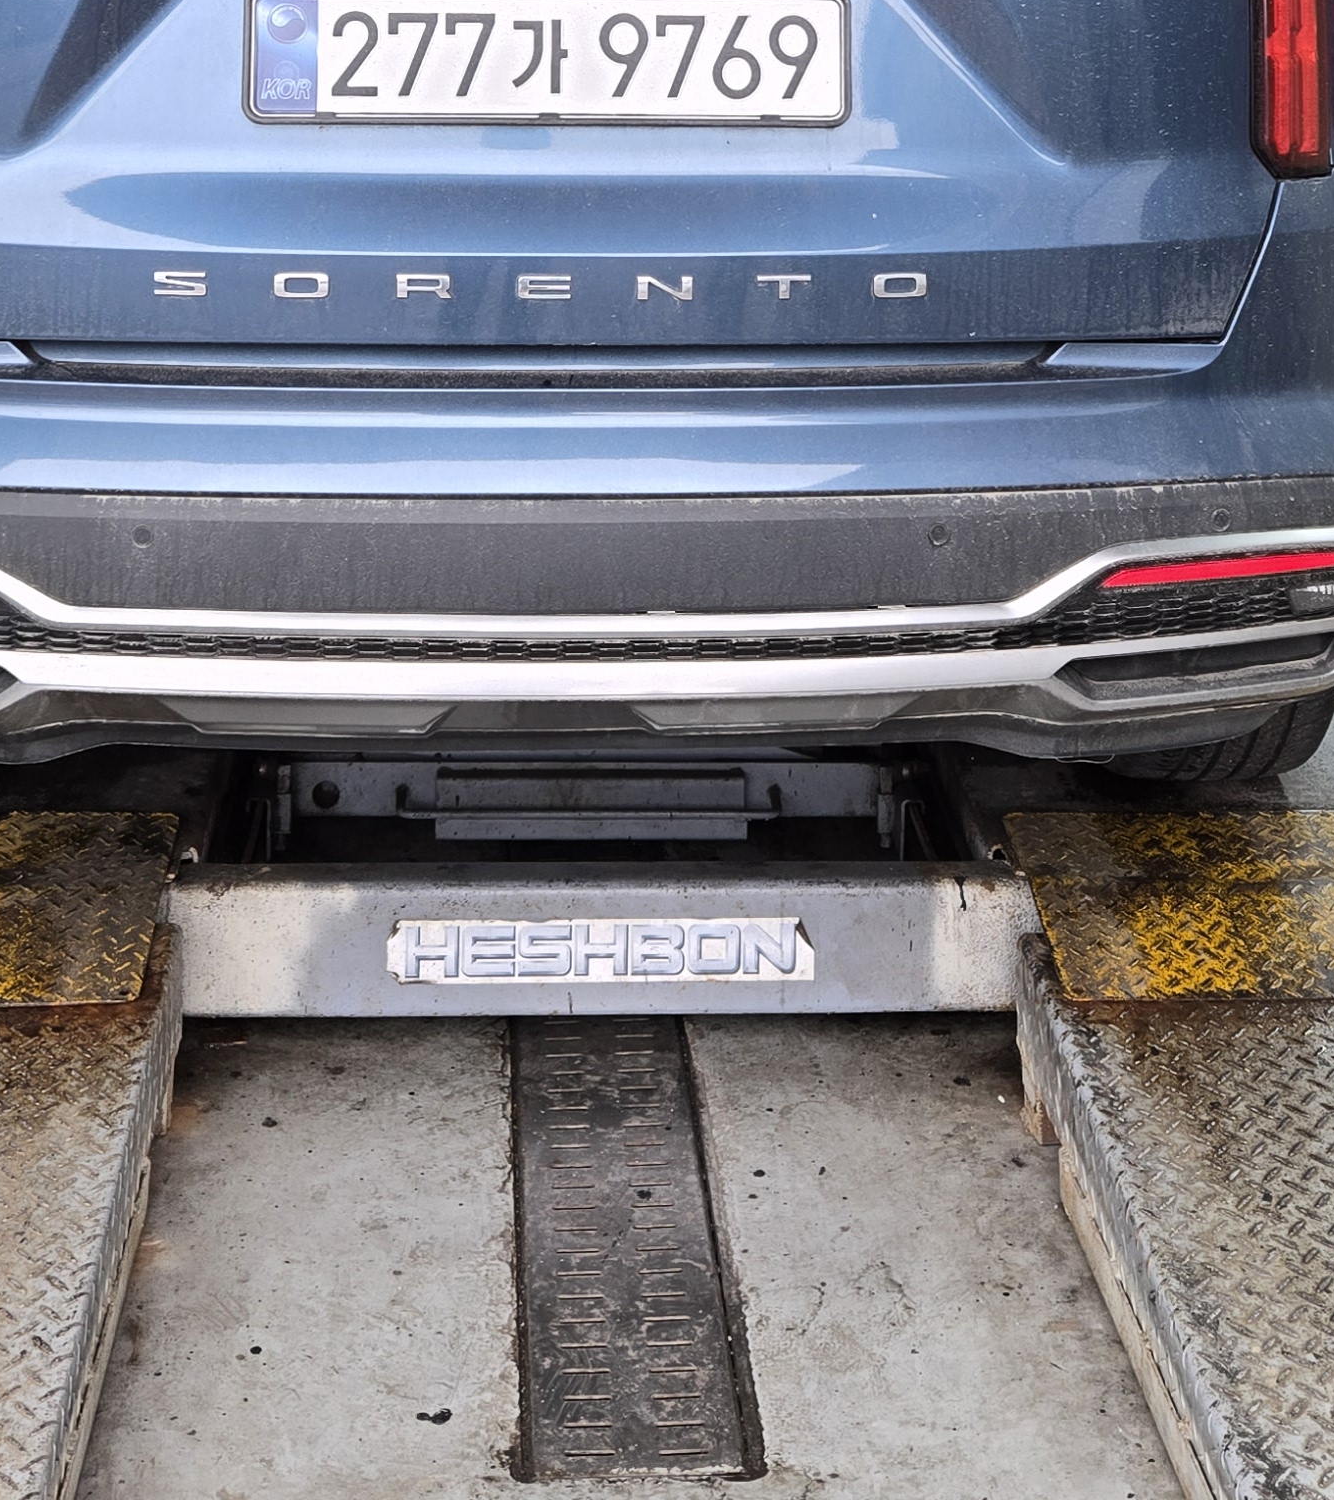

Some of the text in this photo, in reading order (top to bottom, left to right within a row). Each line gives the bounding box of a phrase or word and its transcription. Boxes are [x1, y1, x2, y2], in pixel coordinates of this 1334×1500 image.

[331, 10, 819, 100] 277가 9769
[261, 78, 312, 99] KOR
[153, 271, 928, 300] SORENTO
[404, 923, 798, 979] HESHBON
